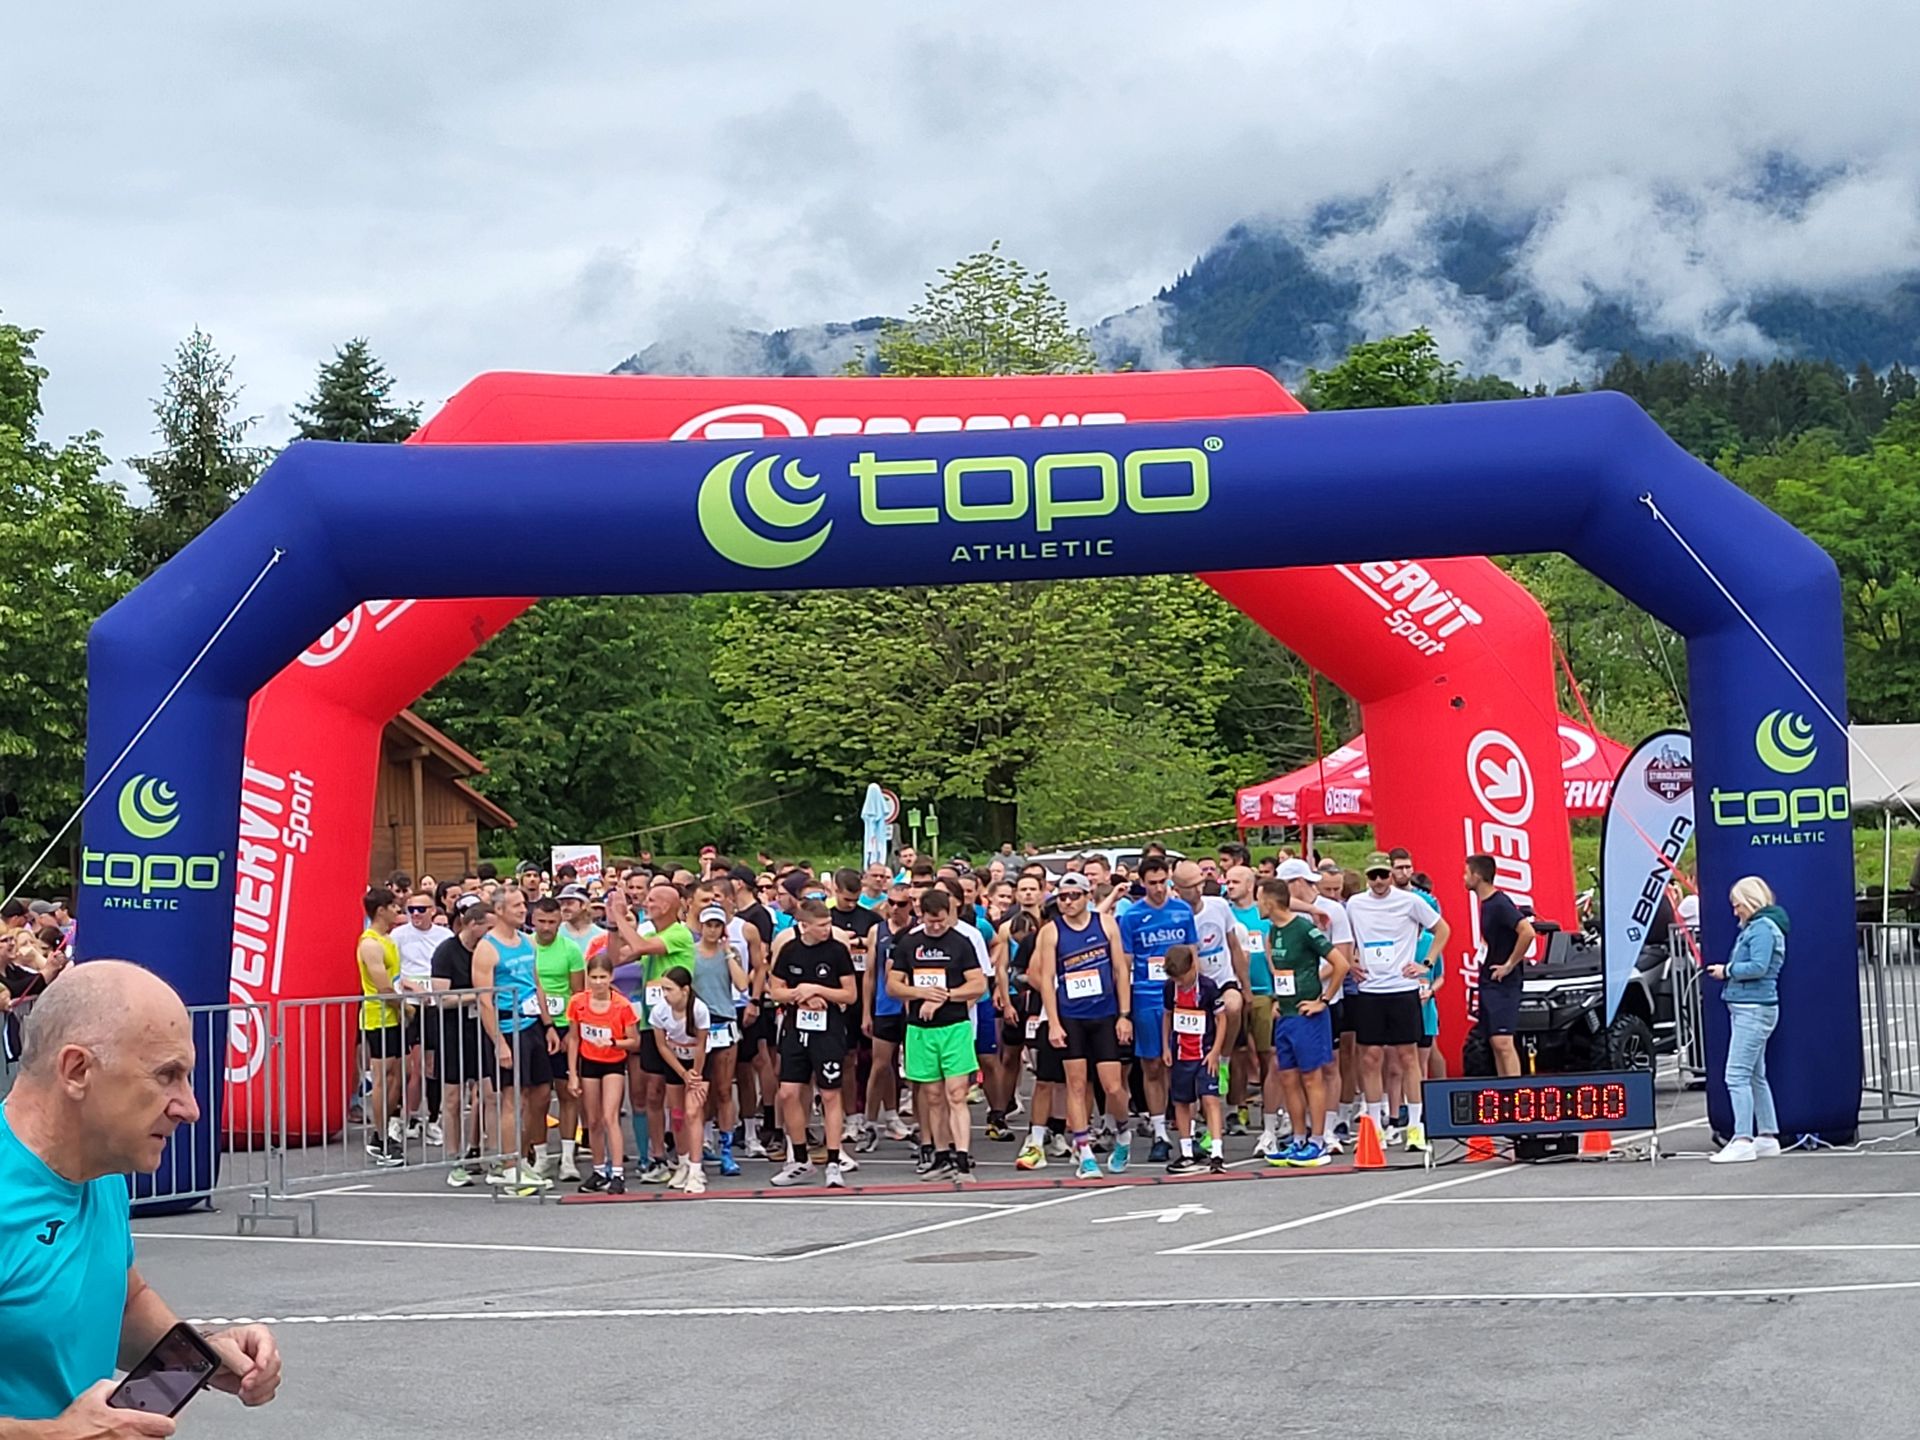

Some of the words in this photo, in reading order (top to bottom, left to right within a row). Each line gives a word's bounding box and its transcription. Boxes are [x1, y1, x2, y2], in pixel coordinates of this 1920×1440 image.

[951, 539, 1114, 563] ATHLETIC
[1384, 608, 1447, 657] Sport
[281, 770, 315, 853] Sport
[1710, 787, 1849, 828] topo
[1751, 831, 1825, 845] ATHLETIC
[1632, 816, 1692, 927] BENDA
[104, 897, 179, 910] ATHLETIC
[919, 975, 939, 986] 220
[1073, 978, 1093, 990] 301
[801, 1011, 820, 1022] 240
[1179, 1014, 1199, 1026] 219
[1477, 1084, 1625, 1124] 0:00:00
